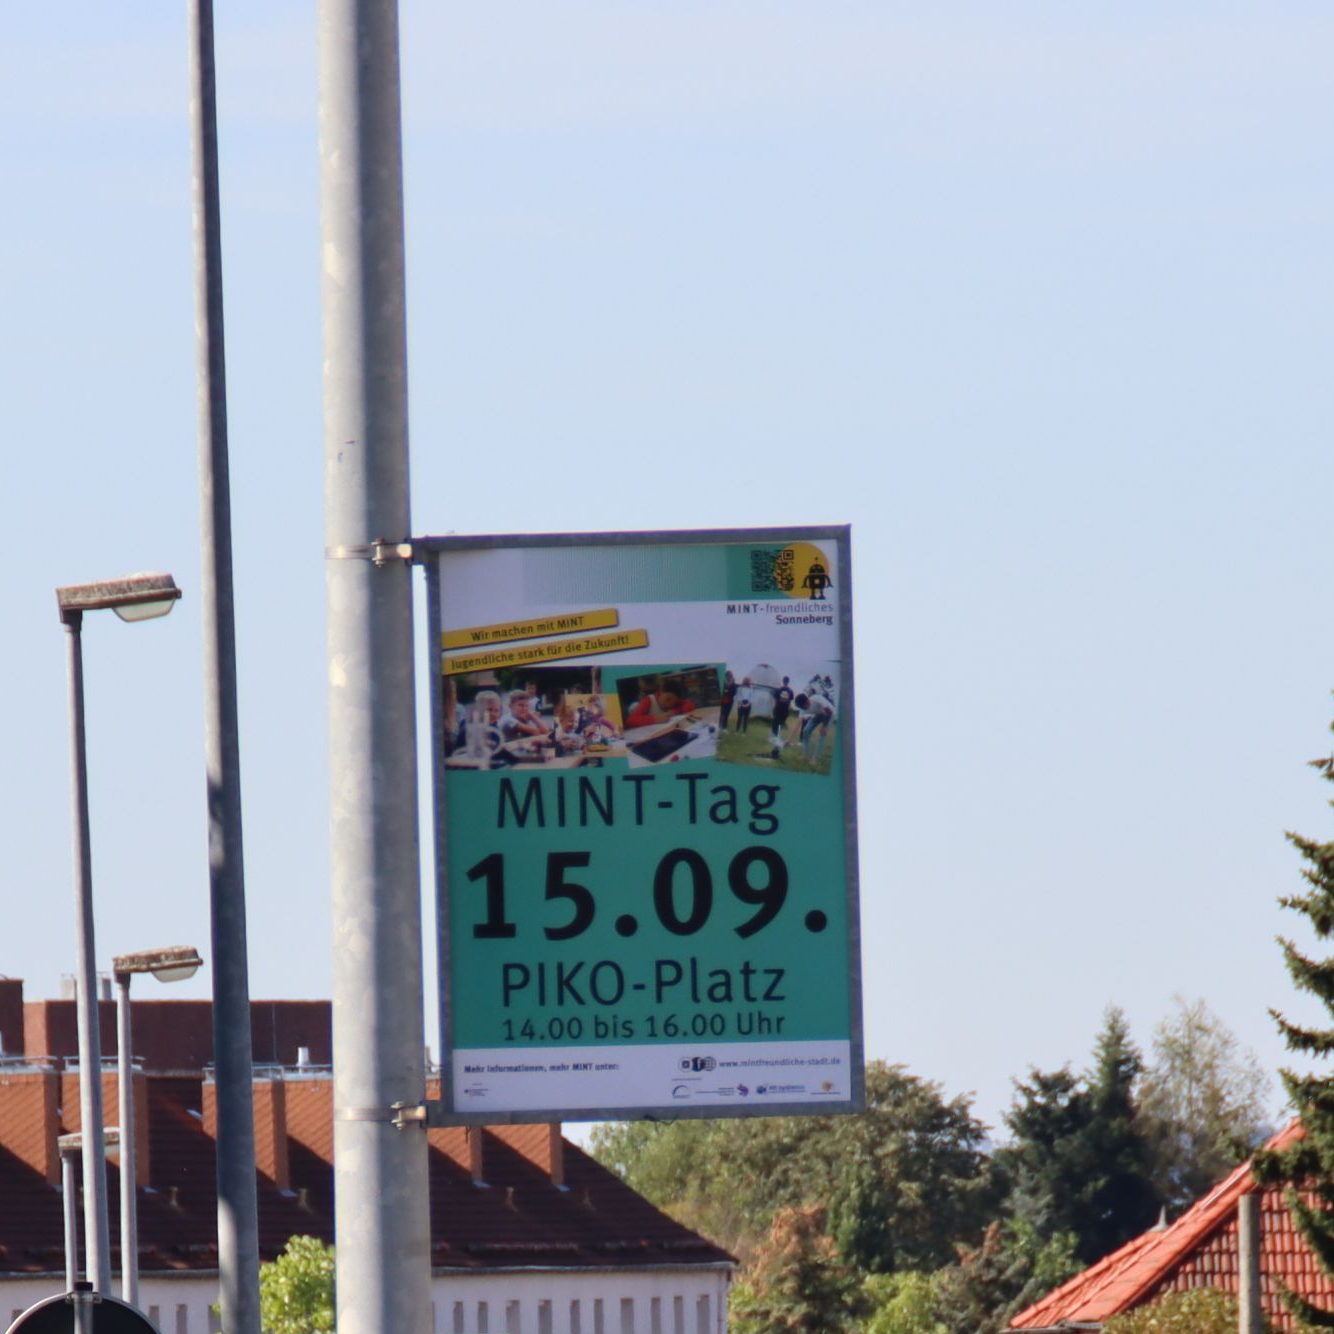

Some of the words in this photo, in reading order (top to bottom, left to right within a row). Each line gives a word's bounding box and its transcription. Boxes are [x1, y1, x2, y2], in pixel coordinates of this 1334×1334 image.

[471, 630, 488, 642] Wir
[492, 623, 533, 639] machen
[537, 619, 554, 632] mit
[557, 616, 584, 629] MINT
[775, 614, 834, 626] Sonneberg
[451, 651, 514, 671] Jugendliche
[518, 647, 544, 660] stark
[547, 644, 562, 656] für
[565, 641, 581, 653] die
[584, 634, 629, 650] Zukunft!
[497, 773, 781, 836] MINT-Tag
[465, 845, 828, 941] 15.09.
[502, 956, 786, 1008] PIKO-Platz
[503, 1016, 583, 1042] 14.00
[593, 1014, 634, 1039] bis
[645, 1012, 727, 1037] 16.00
[737, 1011, 785, 1035] Uhr
[464, 1064, 485, 1073] Mehr
[572, 1062, 593, 1071] MINT
